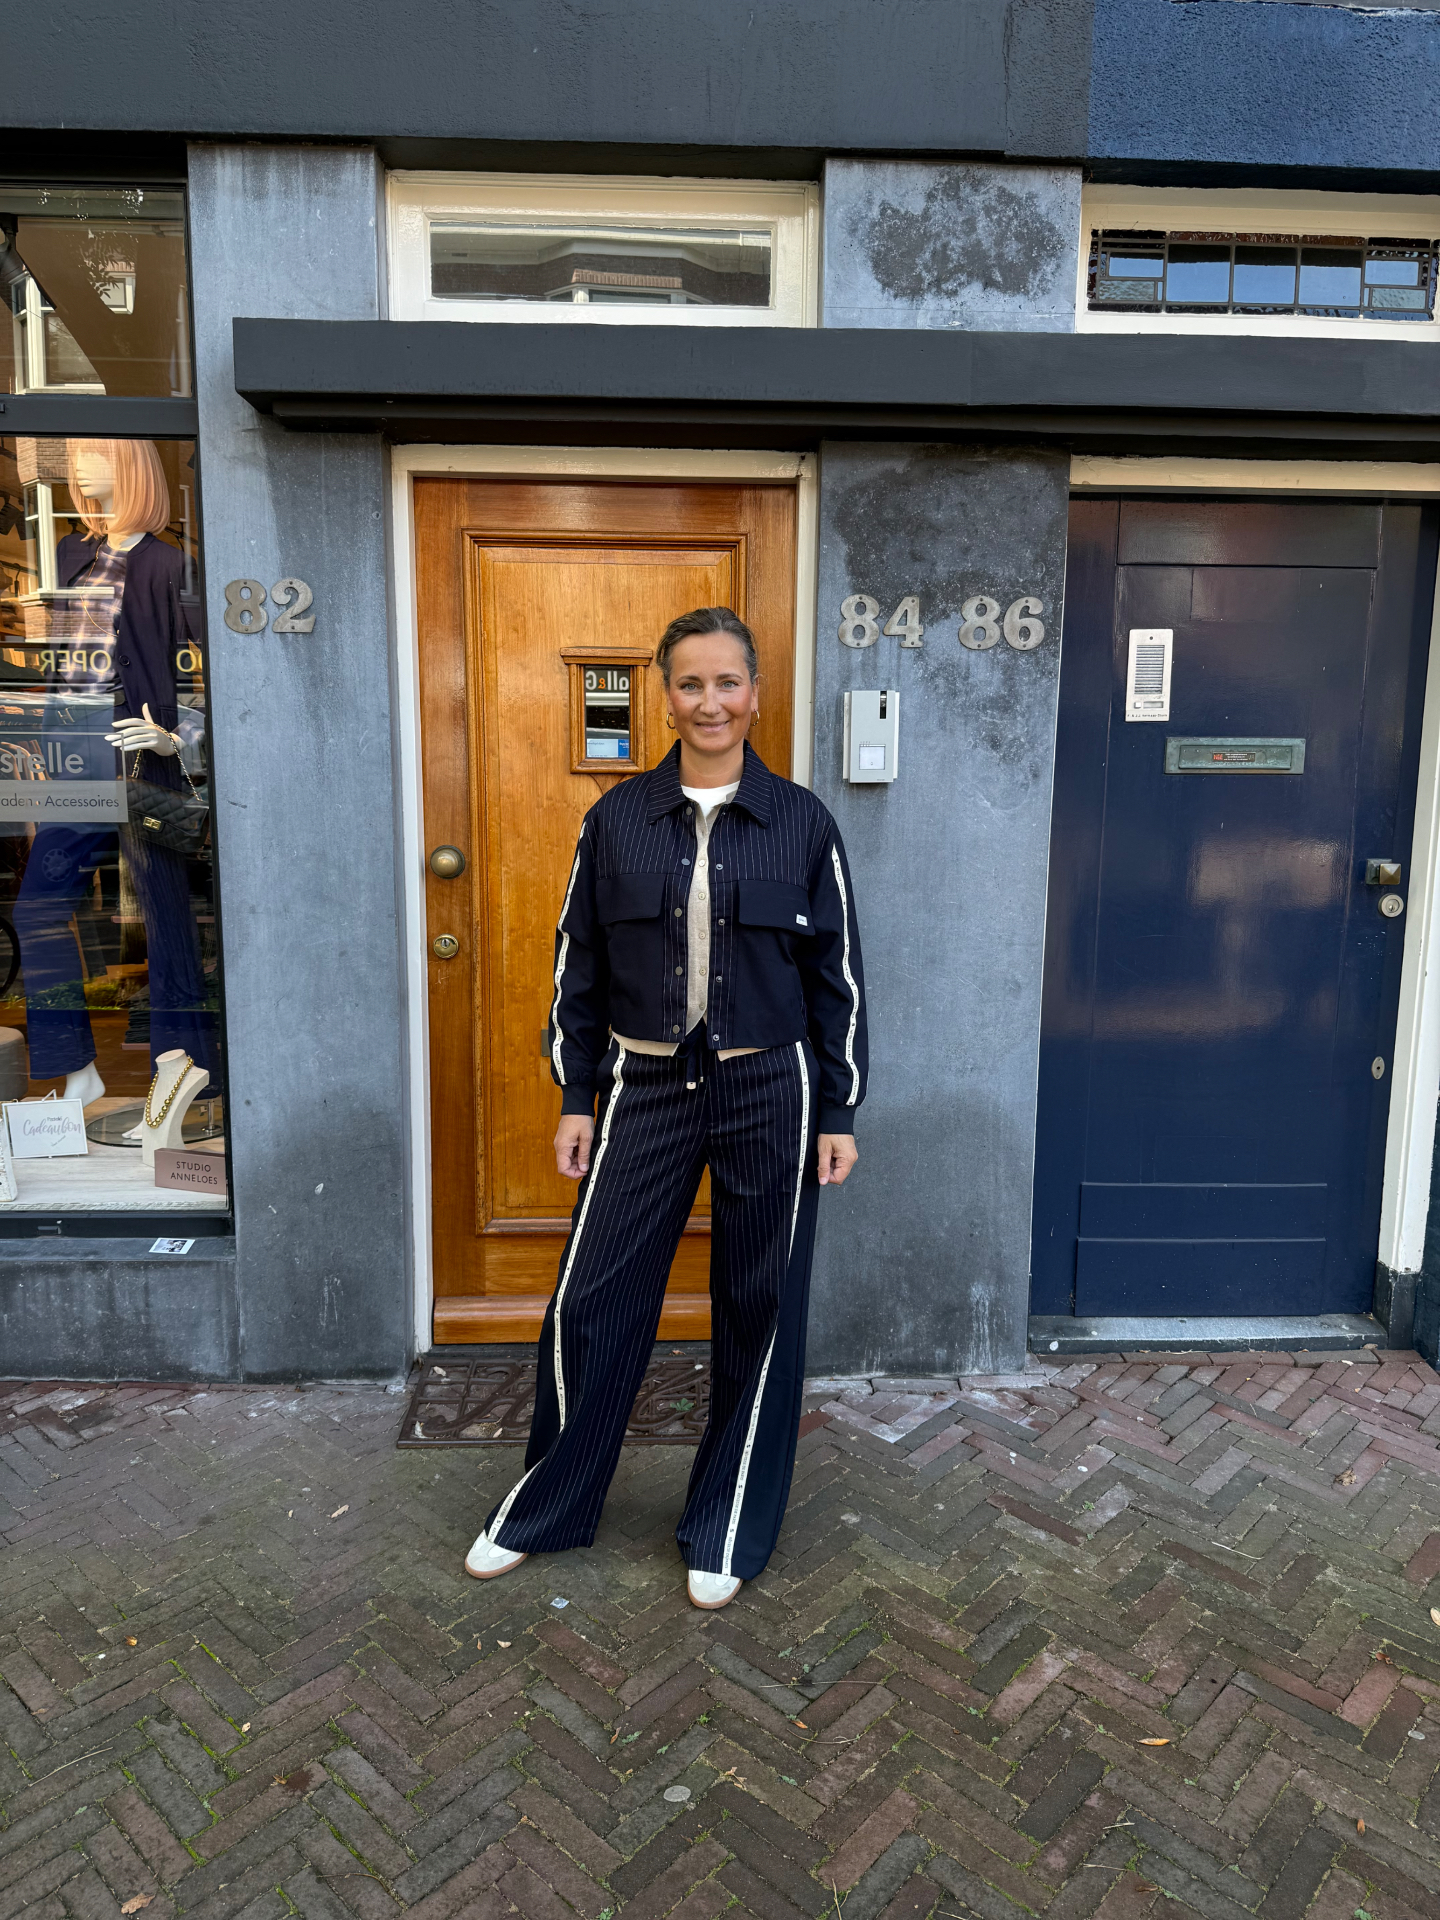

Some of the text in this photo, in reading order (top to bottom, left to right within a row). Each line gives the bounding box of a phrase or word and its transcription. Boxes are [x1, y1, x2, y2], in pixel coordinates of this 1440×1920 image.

[224, 577, 316, 634] 82
[838, 594, 1045, 650] 84 86
[0, 742, 84, 774] stelle
[45, 795, 119, 808] Accessoires
[23, 1116, 82, 1136] Cadeaubon
[176, 1161, 211, 1173] STUDIO
[170, 1172, 218, 1185] ANNELOES
